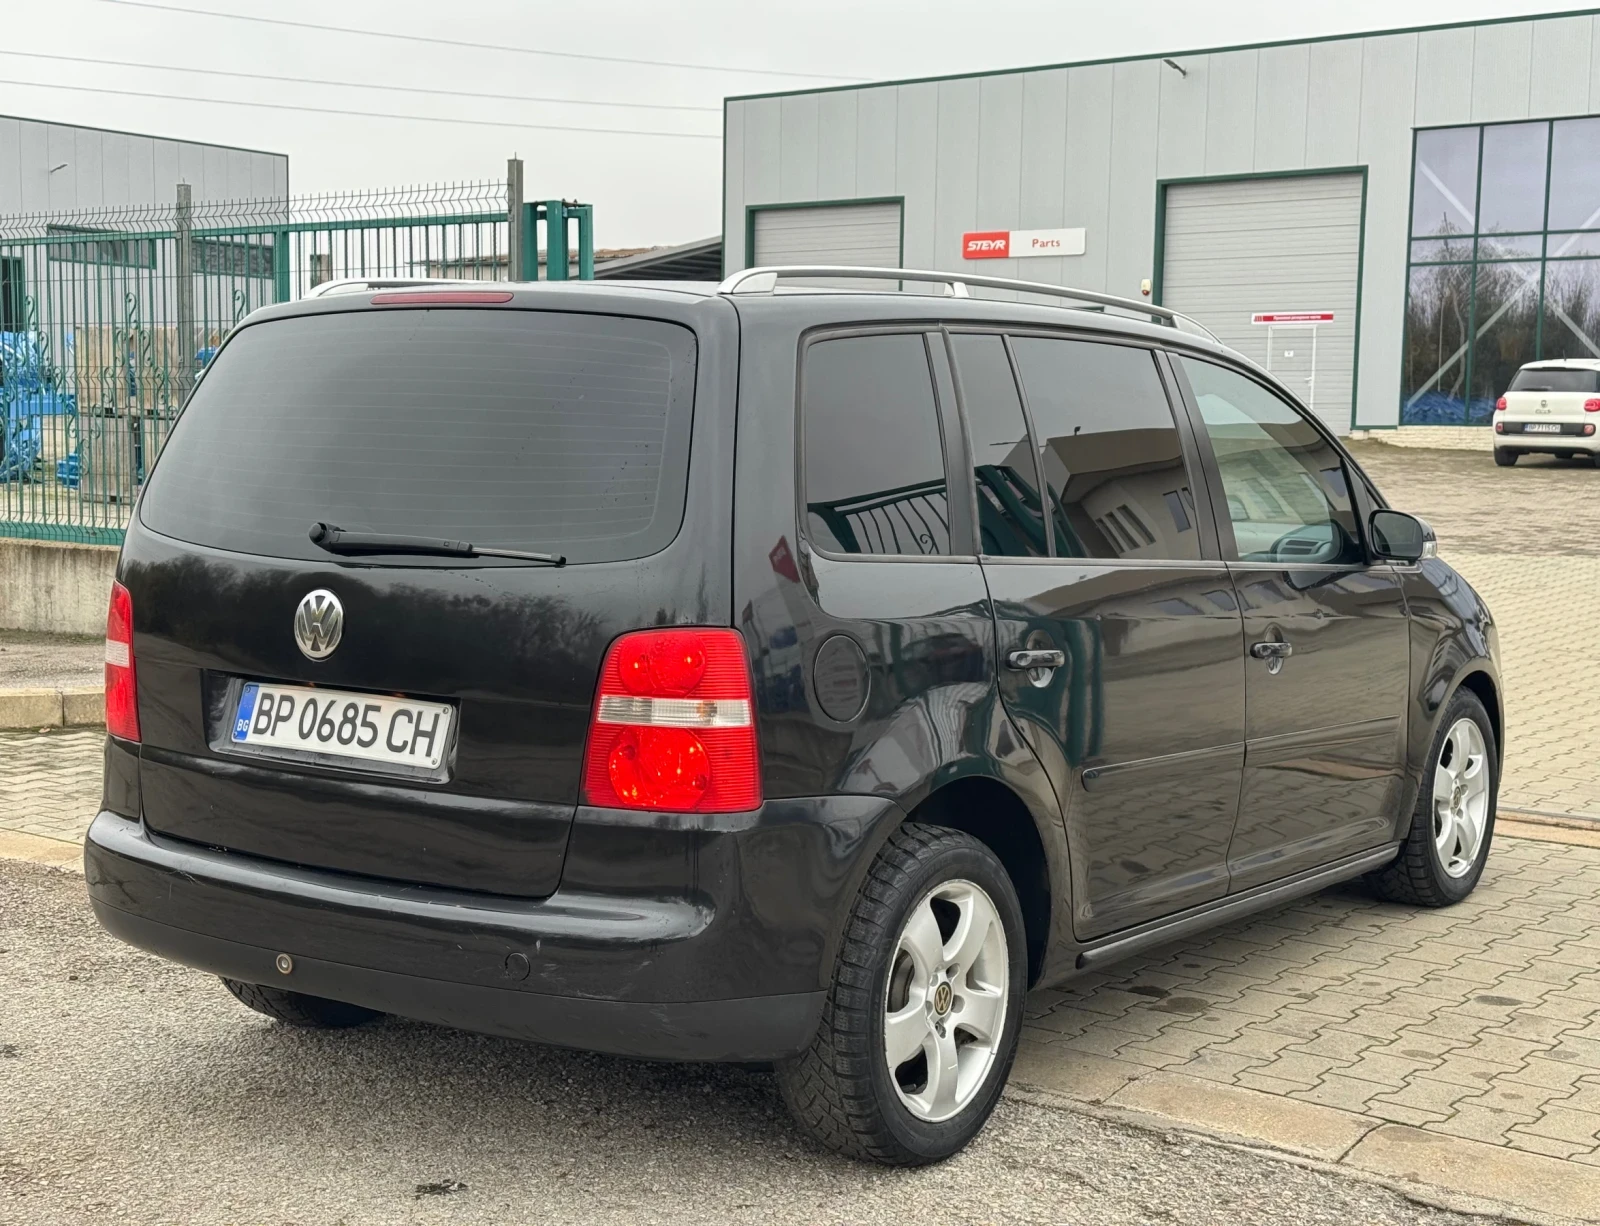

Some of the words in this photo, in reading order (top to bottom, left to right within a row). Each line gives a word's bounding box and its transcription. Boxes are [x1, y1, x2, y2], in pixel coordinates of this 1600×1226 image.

[966, 240, 1006, 252] STEYR
[1032, 238, 1061, 248] Parts
[236, 719, 249, 732] BG
[252, 692, 296, 737] BP
[298, 697, 382, 748] 0685
[386, 708, 440, 757] CH
